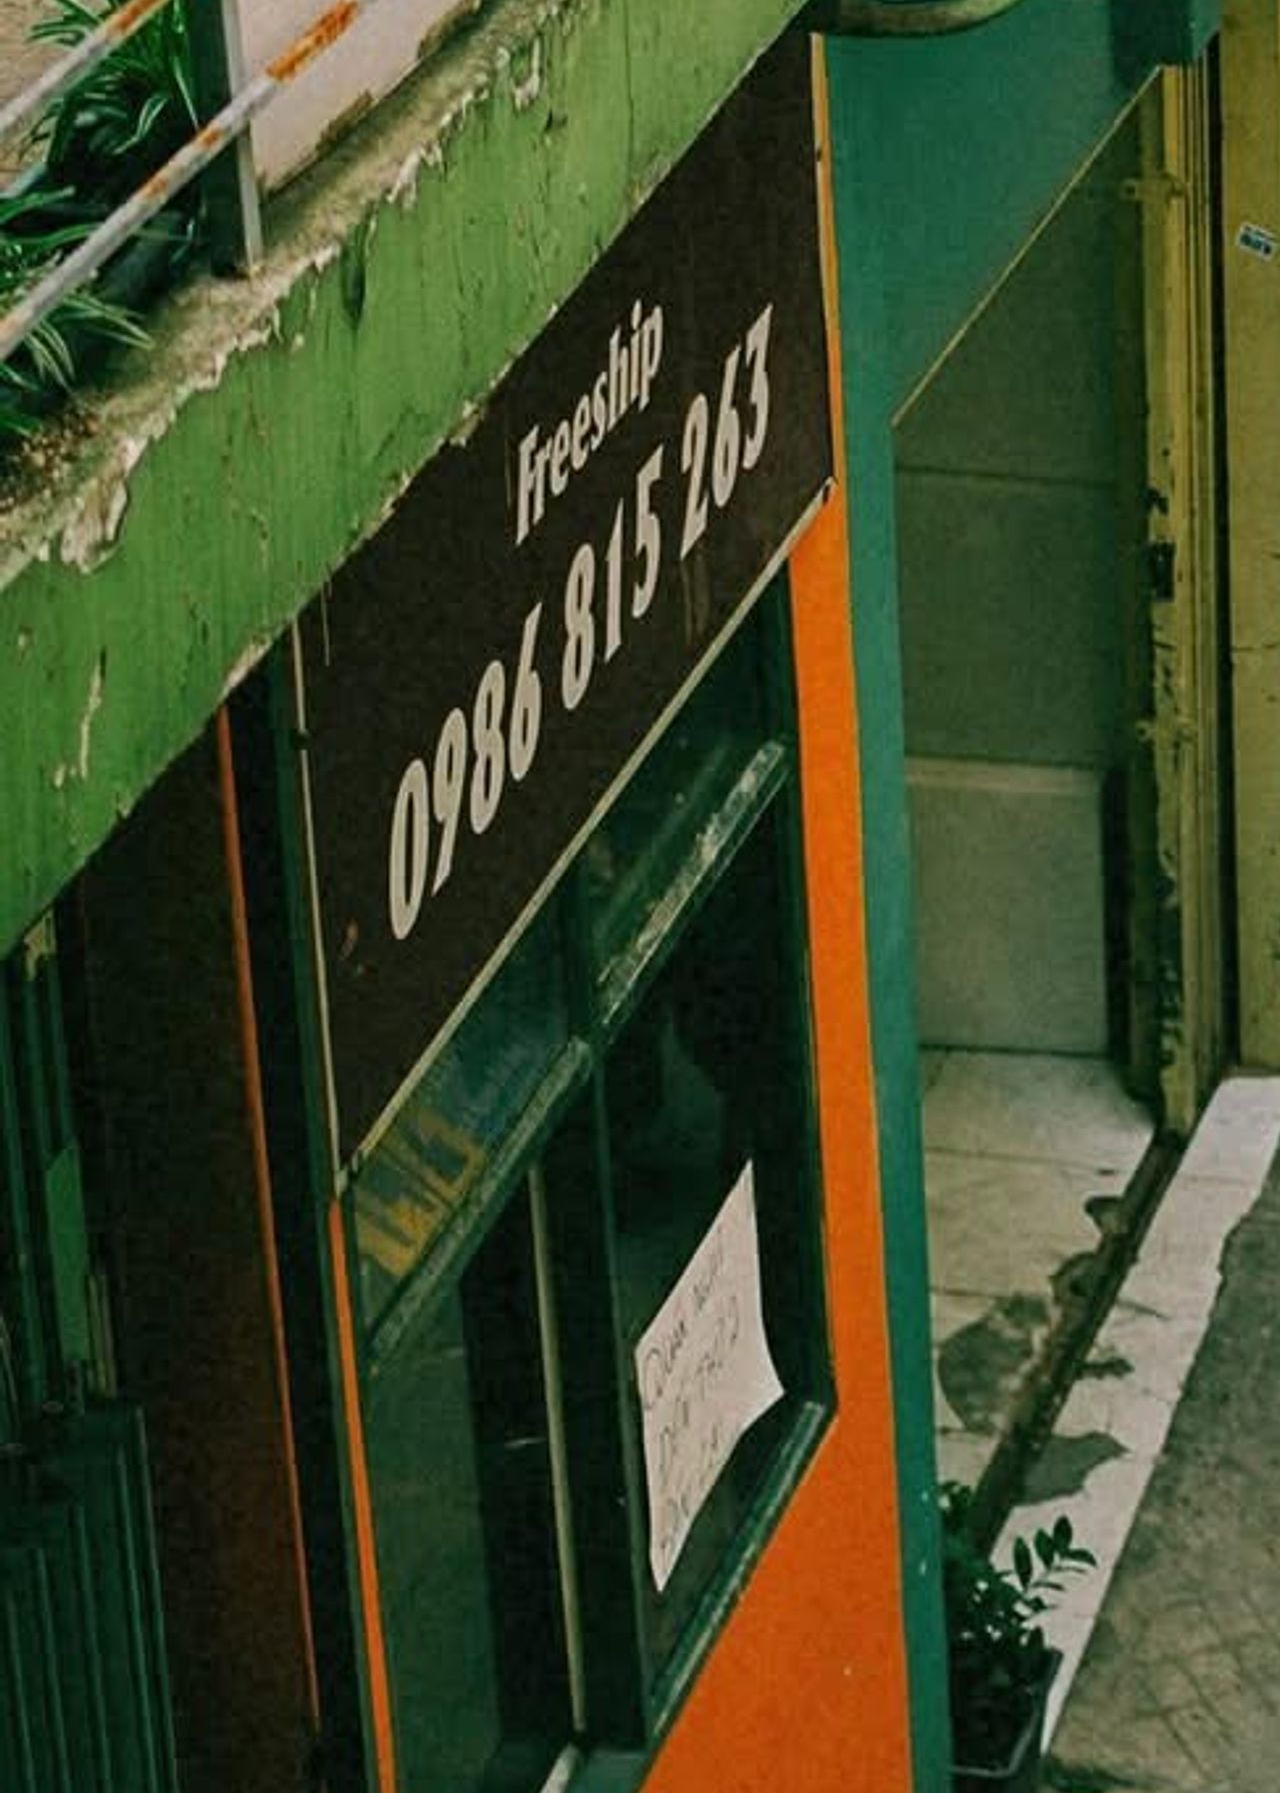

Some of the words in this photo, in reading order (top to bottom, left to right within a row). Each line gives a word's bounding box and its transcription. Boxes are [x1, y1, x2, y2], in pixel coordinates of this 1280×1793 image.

[388, 601, 544, 941] 0986
[561, 443, 665, 711] 815
[680, 303, 774, 562] 263
[514, 298, 664, 547] Freeship
